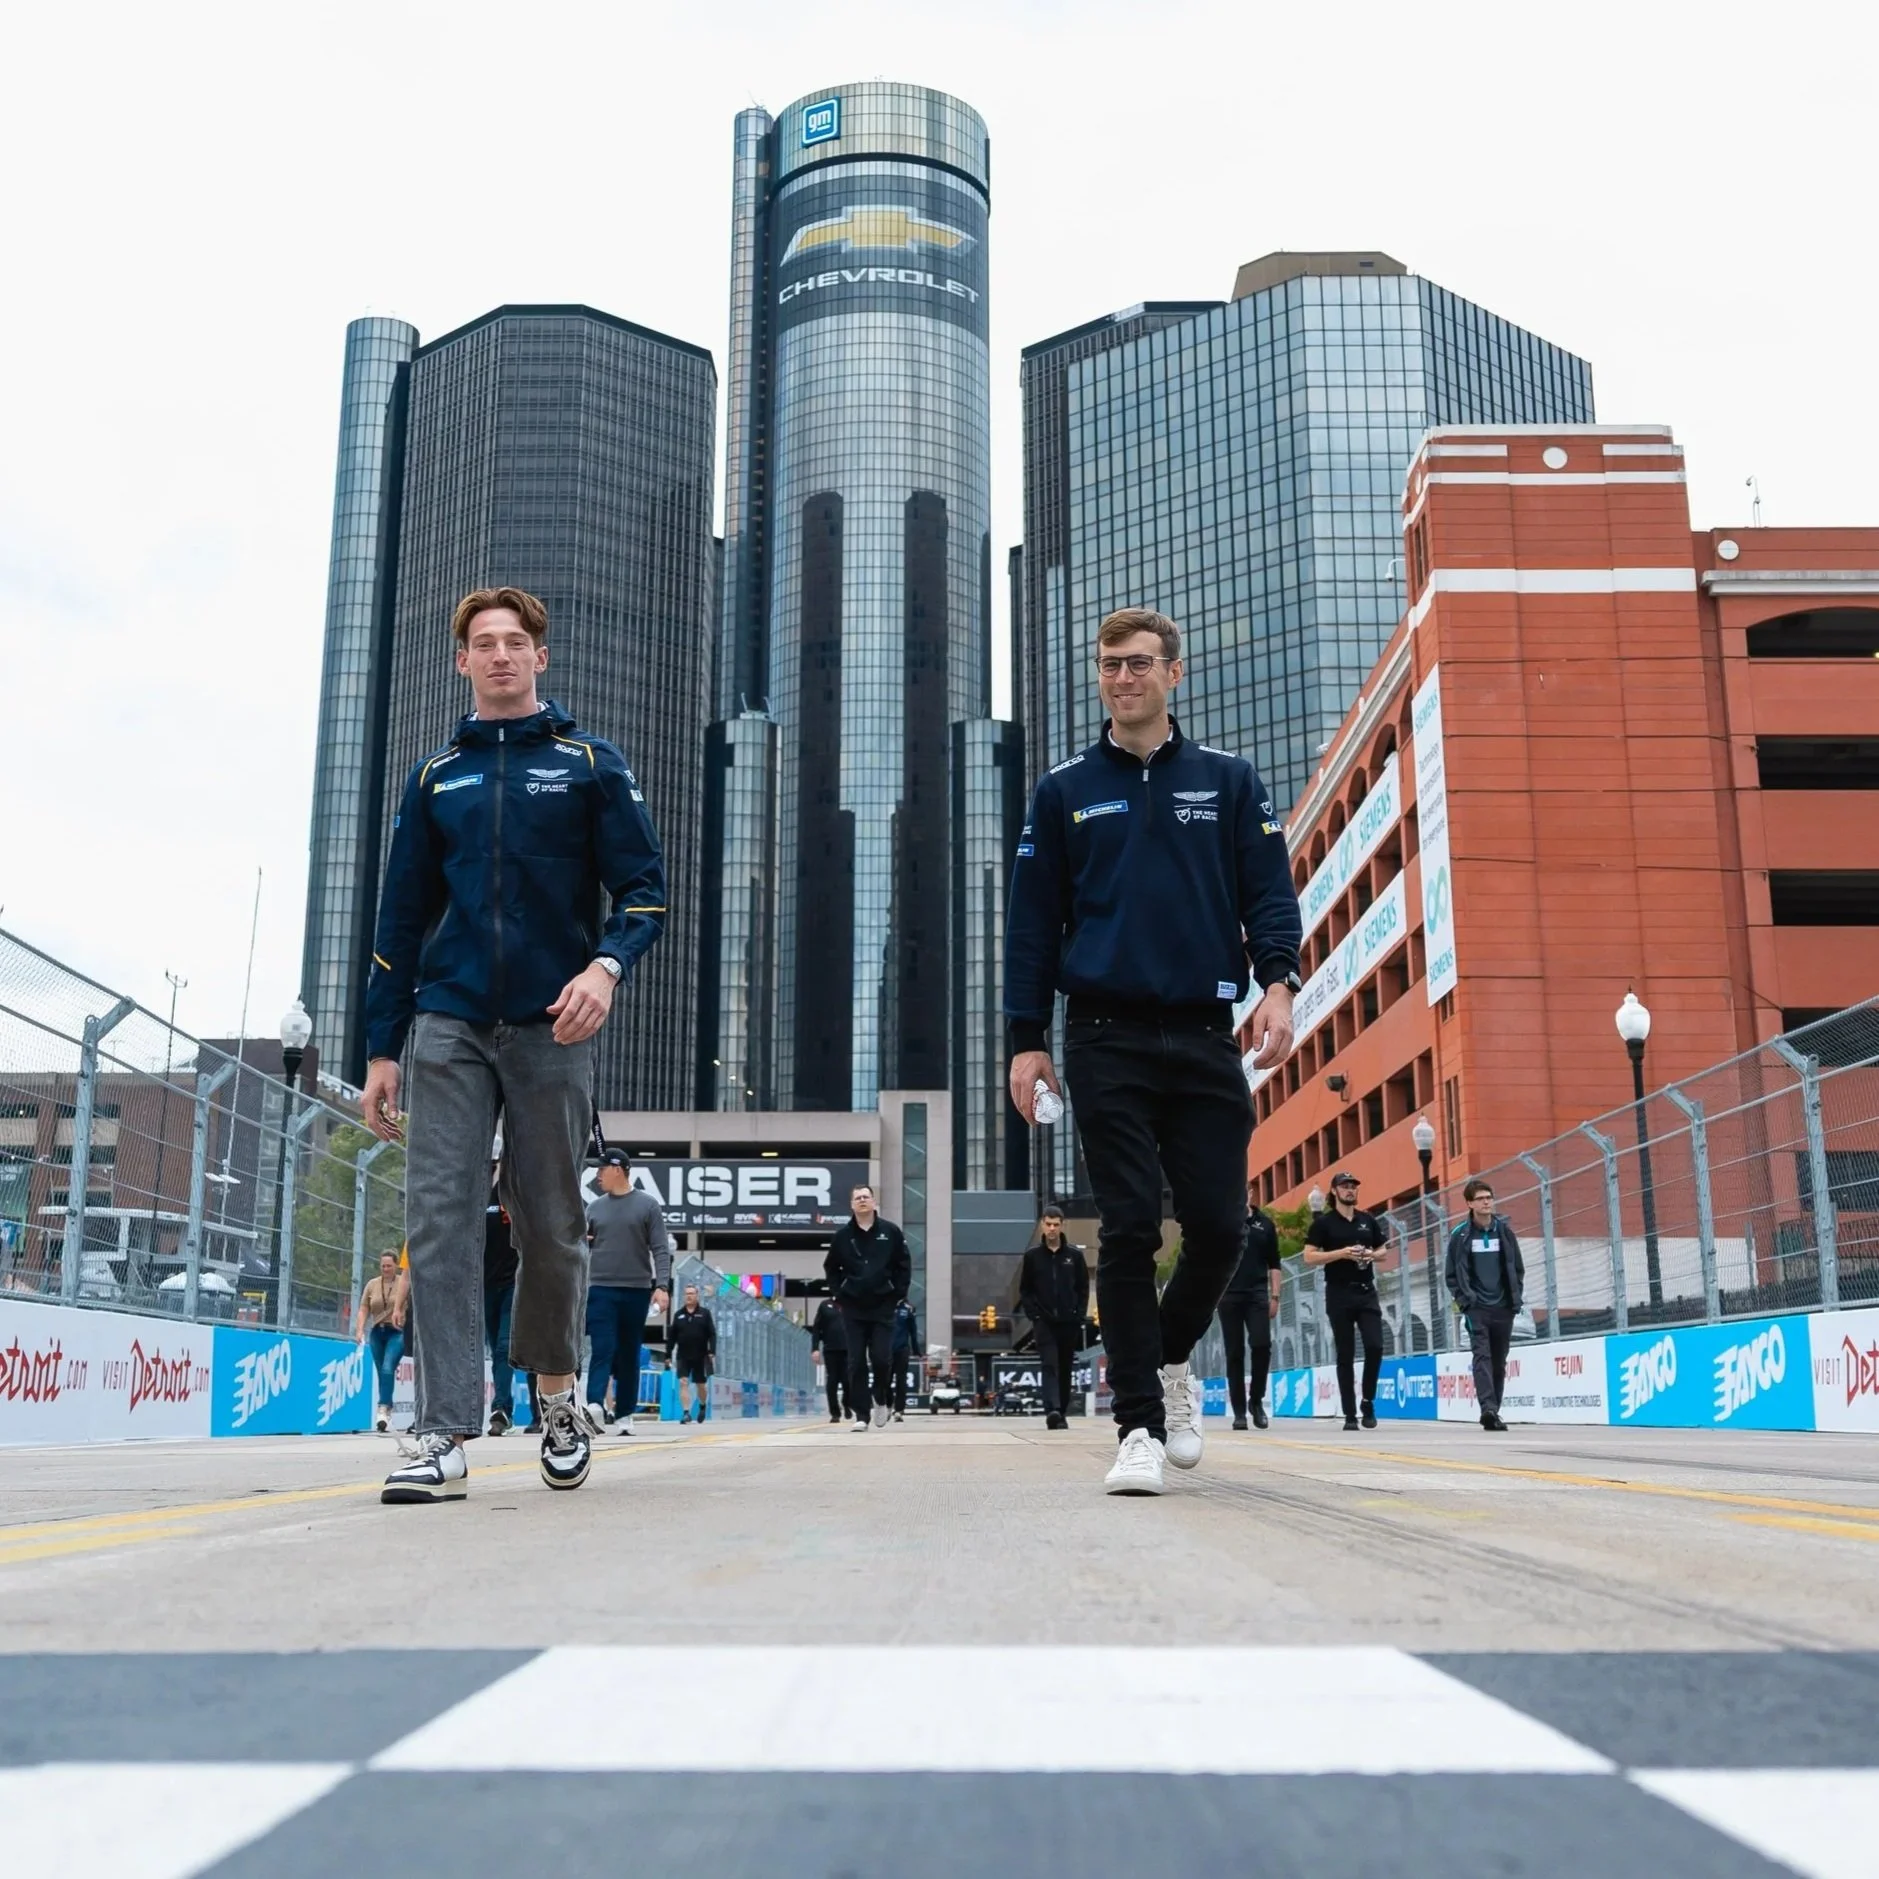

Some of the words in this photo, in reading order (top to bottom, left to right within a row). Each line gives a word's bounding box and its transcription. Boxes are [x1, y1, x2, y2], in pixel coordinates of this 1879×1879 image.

[808, 110, 831, 133] gm
[779, 267, 979, 304] CHEVROLET
[1360, 782, 1391, 849] SIEMENS
[1364, 896, 1397, 957] SIEMENS
[103, 1360, 129, 1390] VISIT
[232, 1338, 291, 1429] FAYGO
[1554, 1354, 1583, 1379] TEIJIN
[1620, 1335, 1677, 1419] FAYGO
[1714, 1324, 1786, 1422] FAYGO
[1815, 1358, 1841, 1386] VISIT
